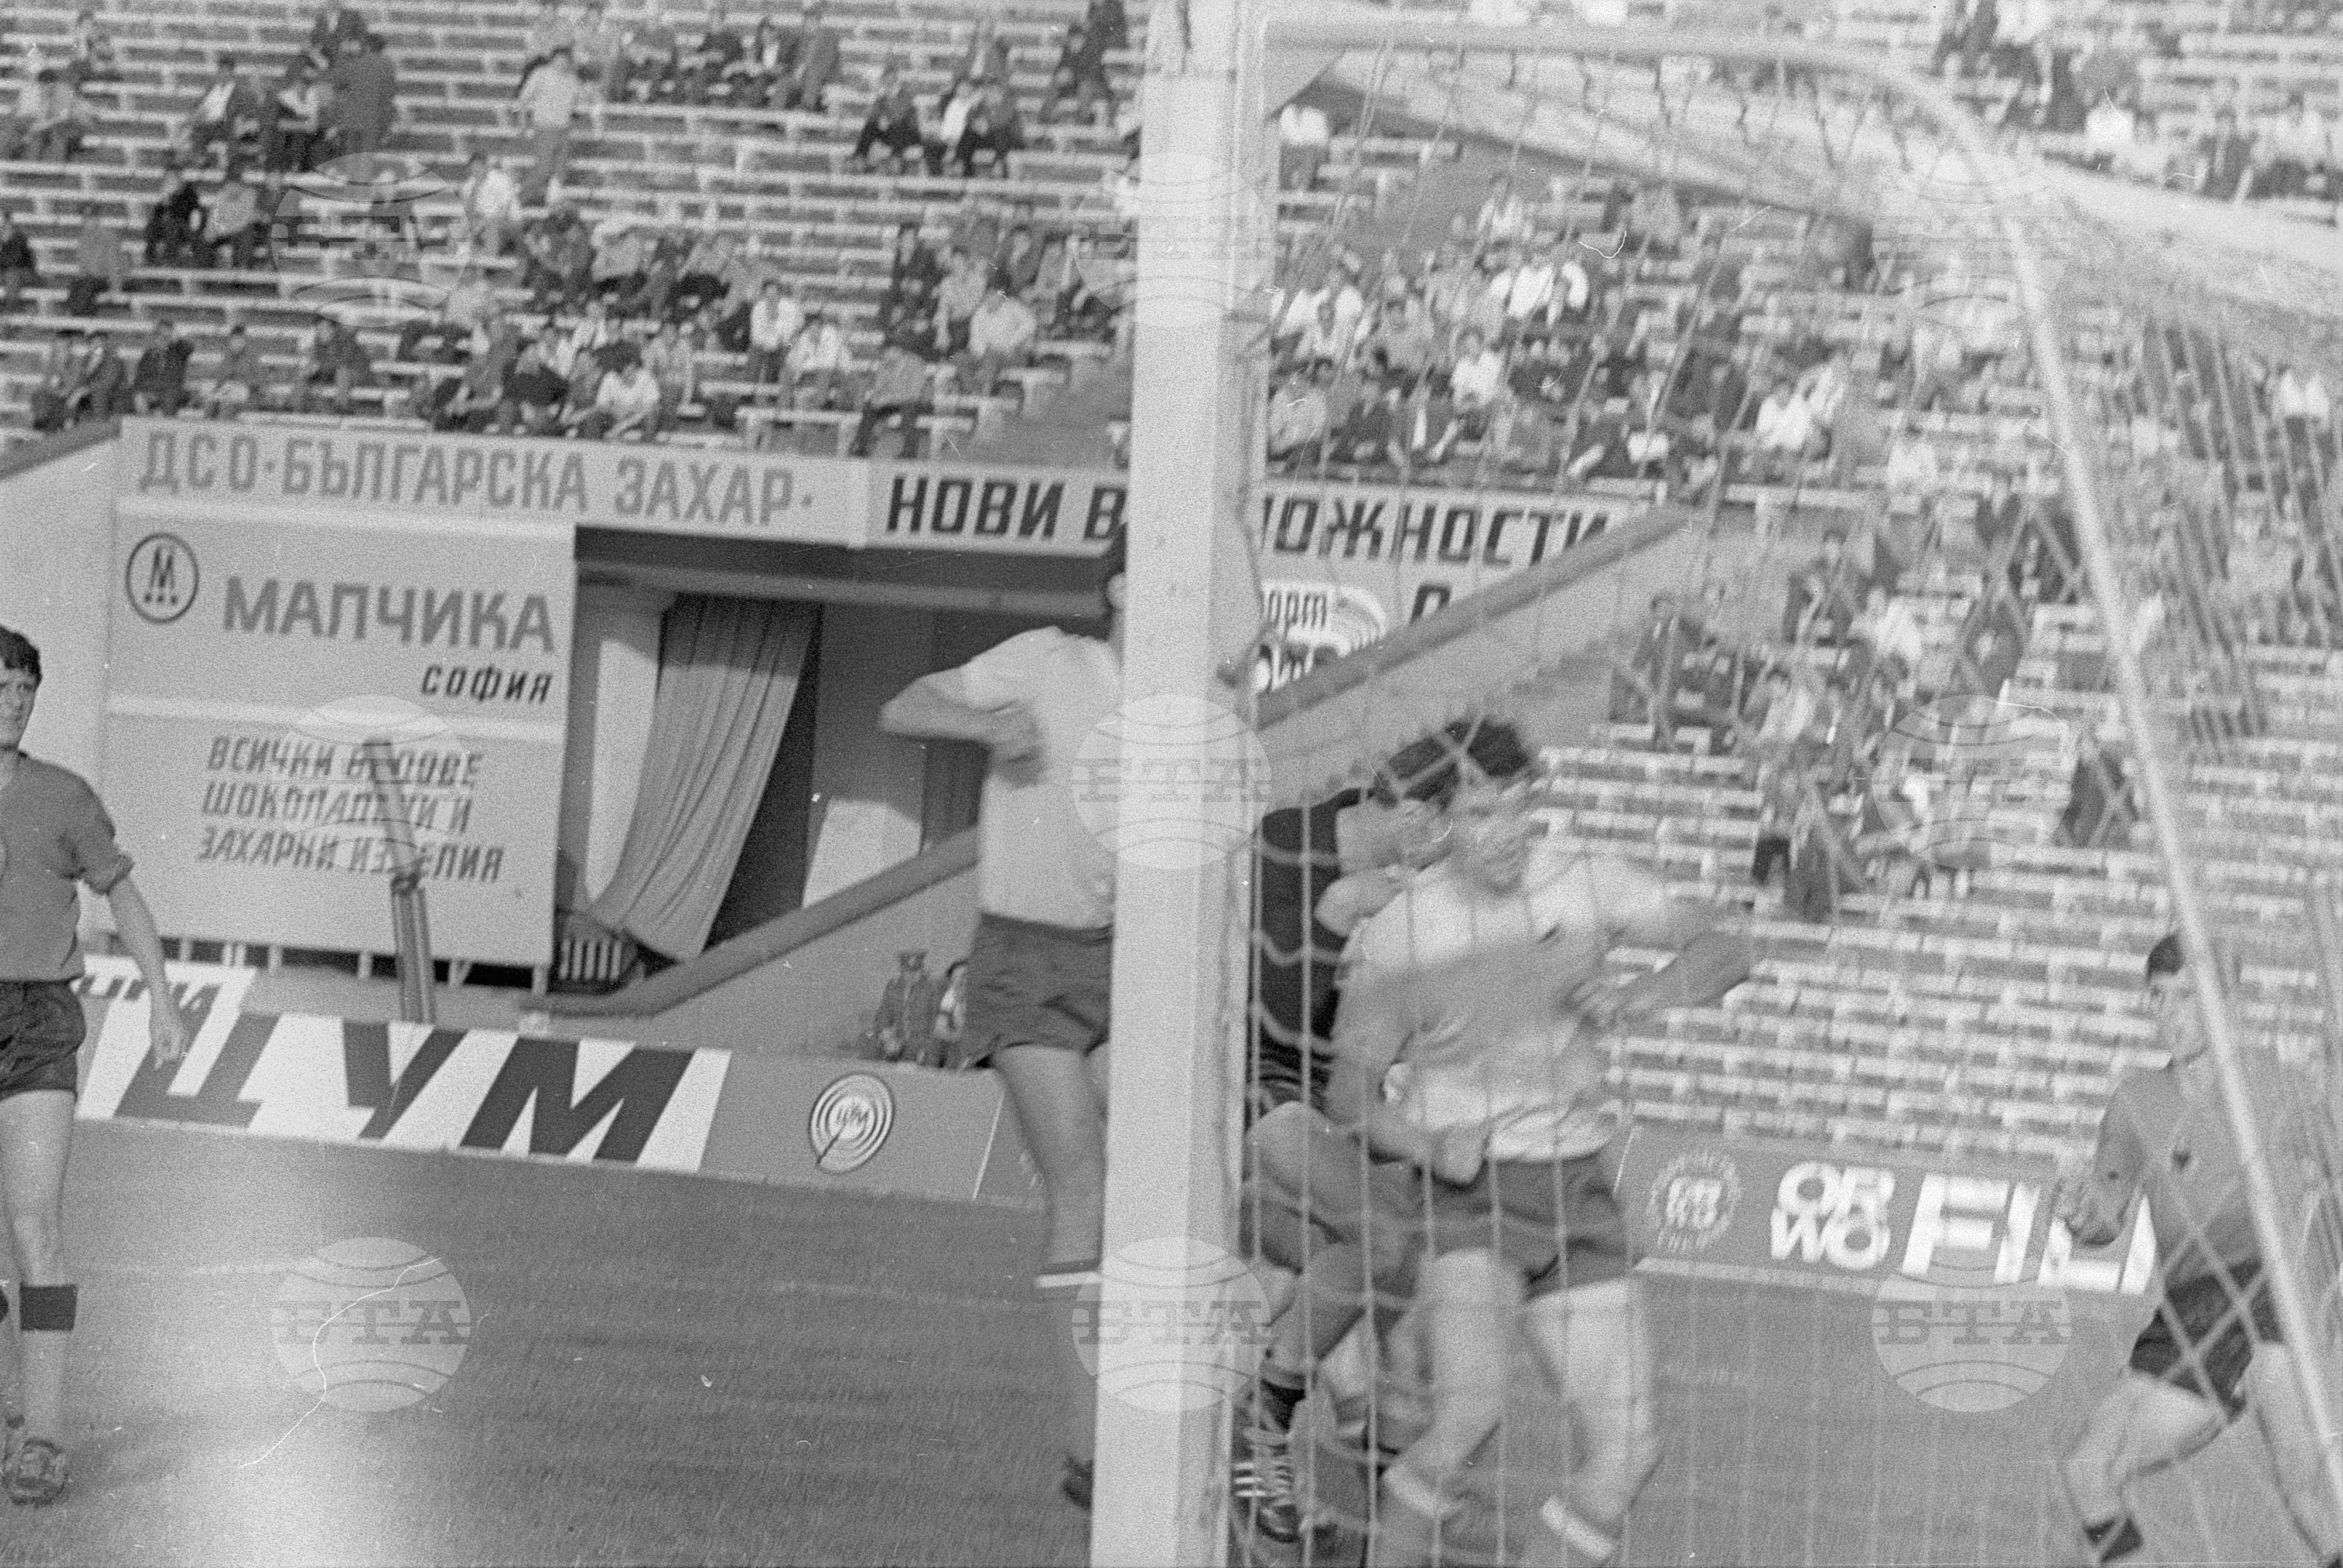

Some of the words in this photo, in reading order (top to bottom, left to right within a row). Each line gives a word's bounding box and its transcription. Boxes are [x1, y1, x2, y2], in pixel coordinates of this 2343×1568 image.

[137, 431, 258, 494] ДСО
[887, 475, 1066, 539] НОВИ
[421, 663, 553, 704] СОФИЯ
[207, 735, 337, 778] ВСИЧКИ
[344, 744, 484, 789] ВДОВЕ
[347, 836, 505, 883] ИЗЕЛИЯ
[1901, 1173, 2158, 1294] FIL
